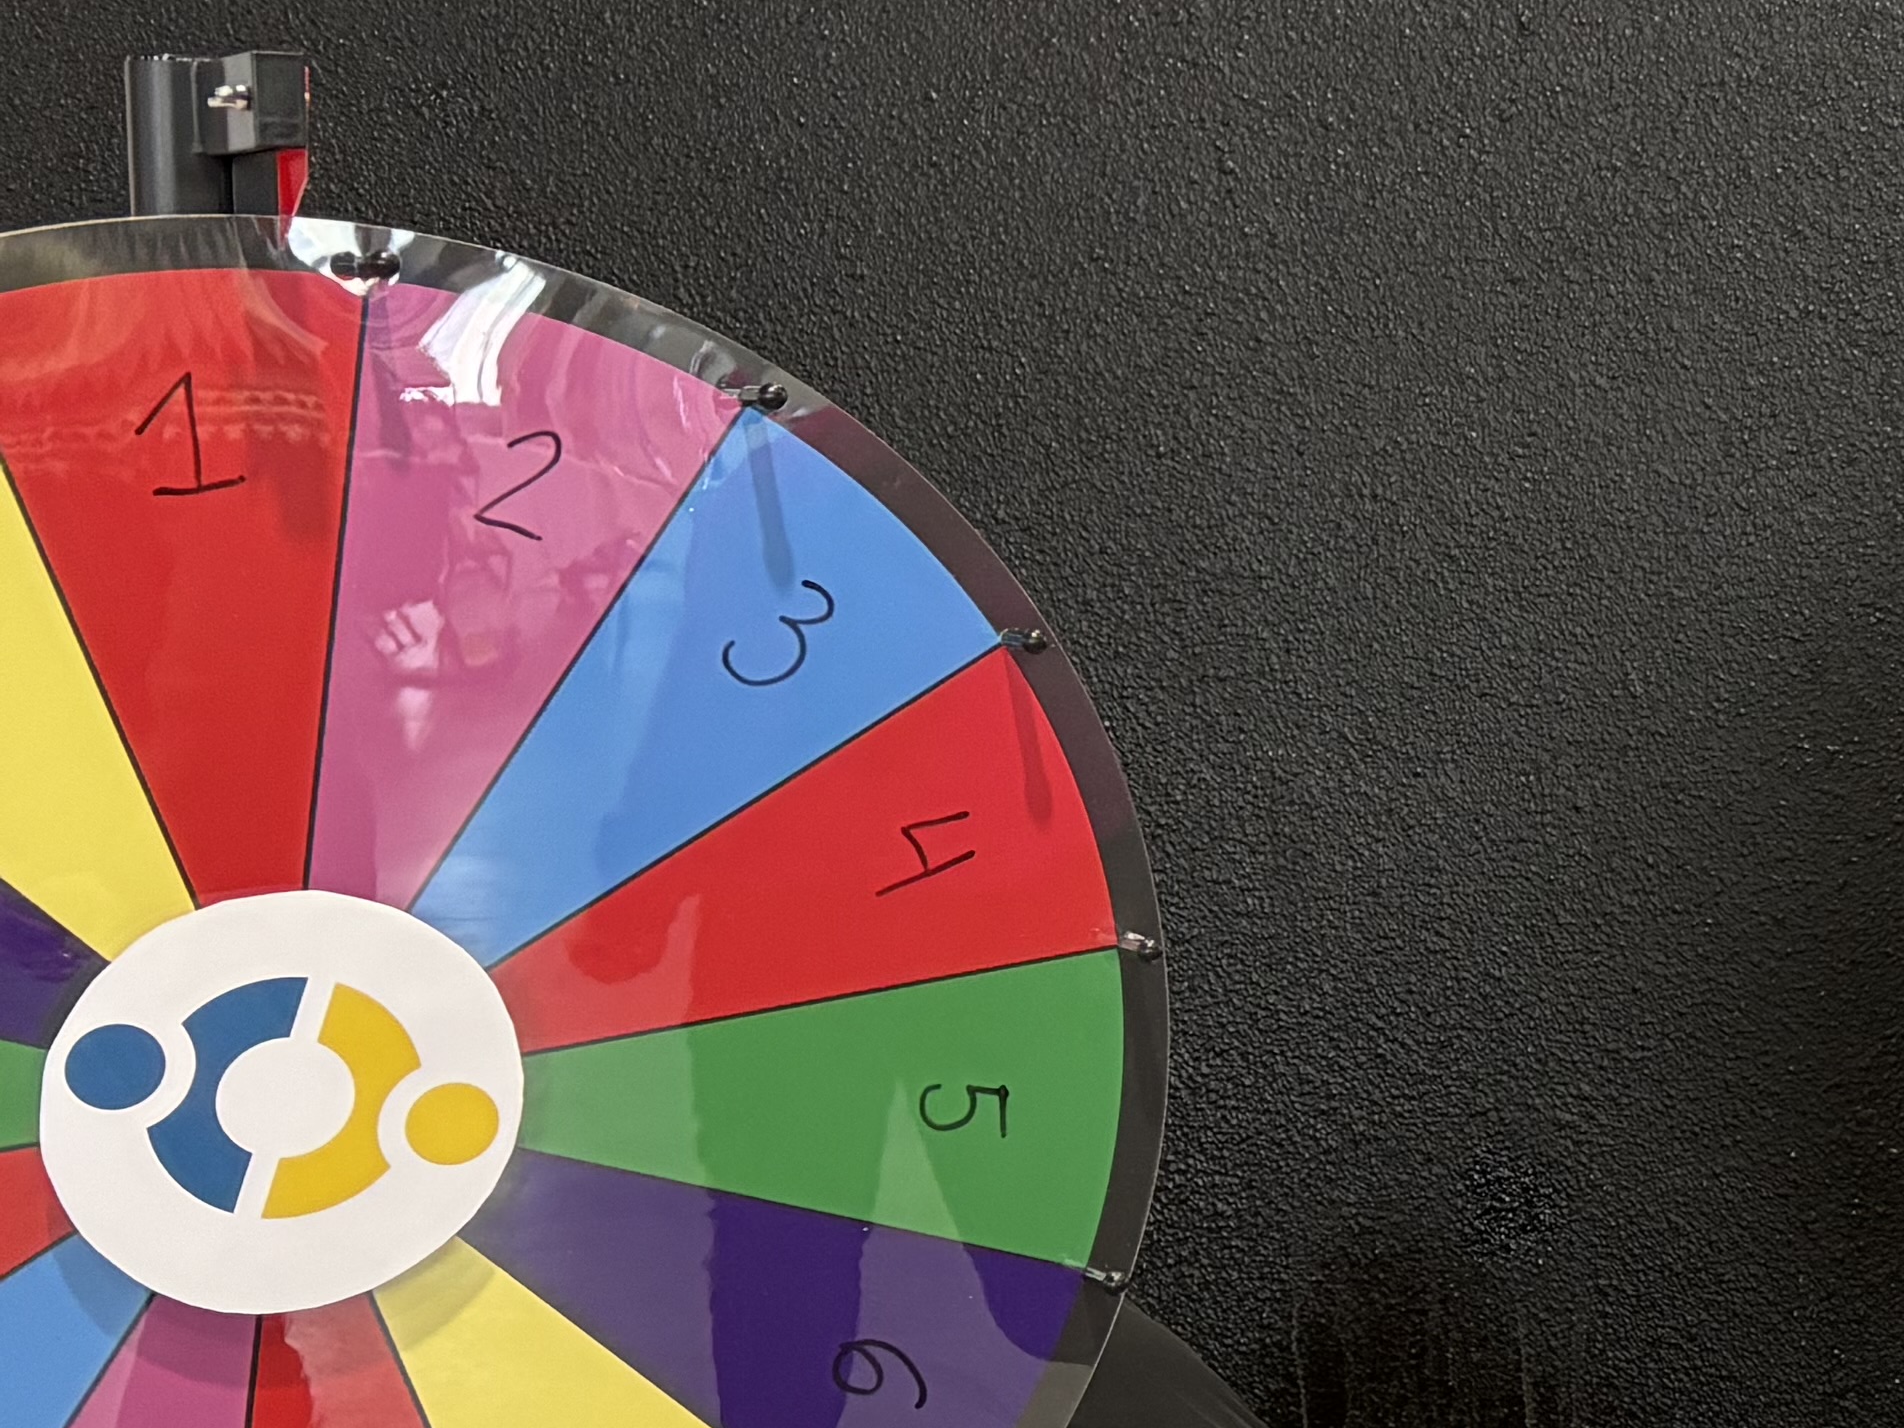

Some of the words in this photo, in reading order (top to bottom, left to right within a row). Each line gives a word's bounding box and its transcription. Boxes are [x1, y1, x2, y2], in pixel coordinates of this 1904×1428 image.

[135, 371, 246, 496] 1
[473, 428, 563, 541] 2
[720, 579, 835, 686] 3
[873, 809, 976, 898] 4
[918, 1082, 1010, 1140] 5
[832, 1338, 927, 1410] 6
